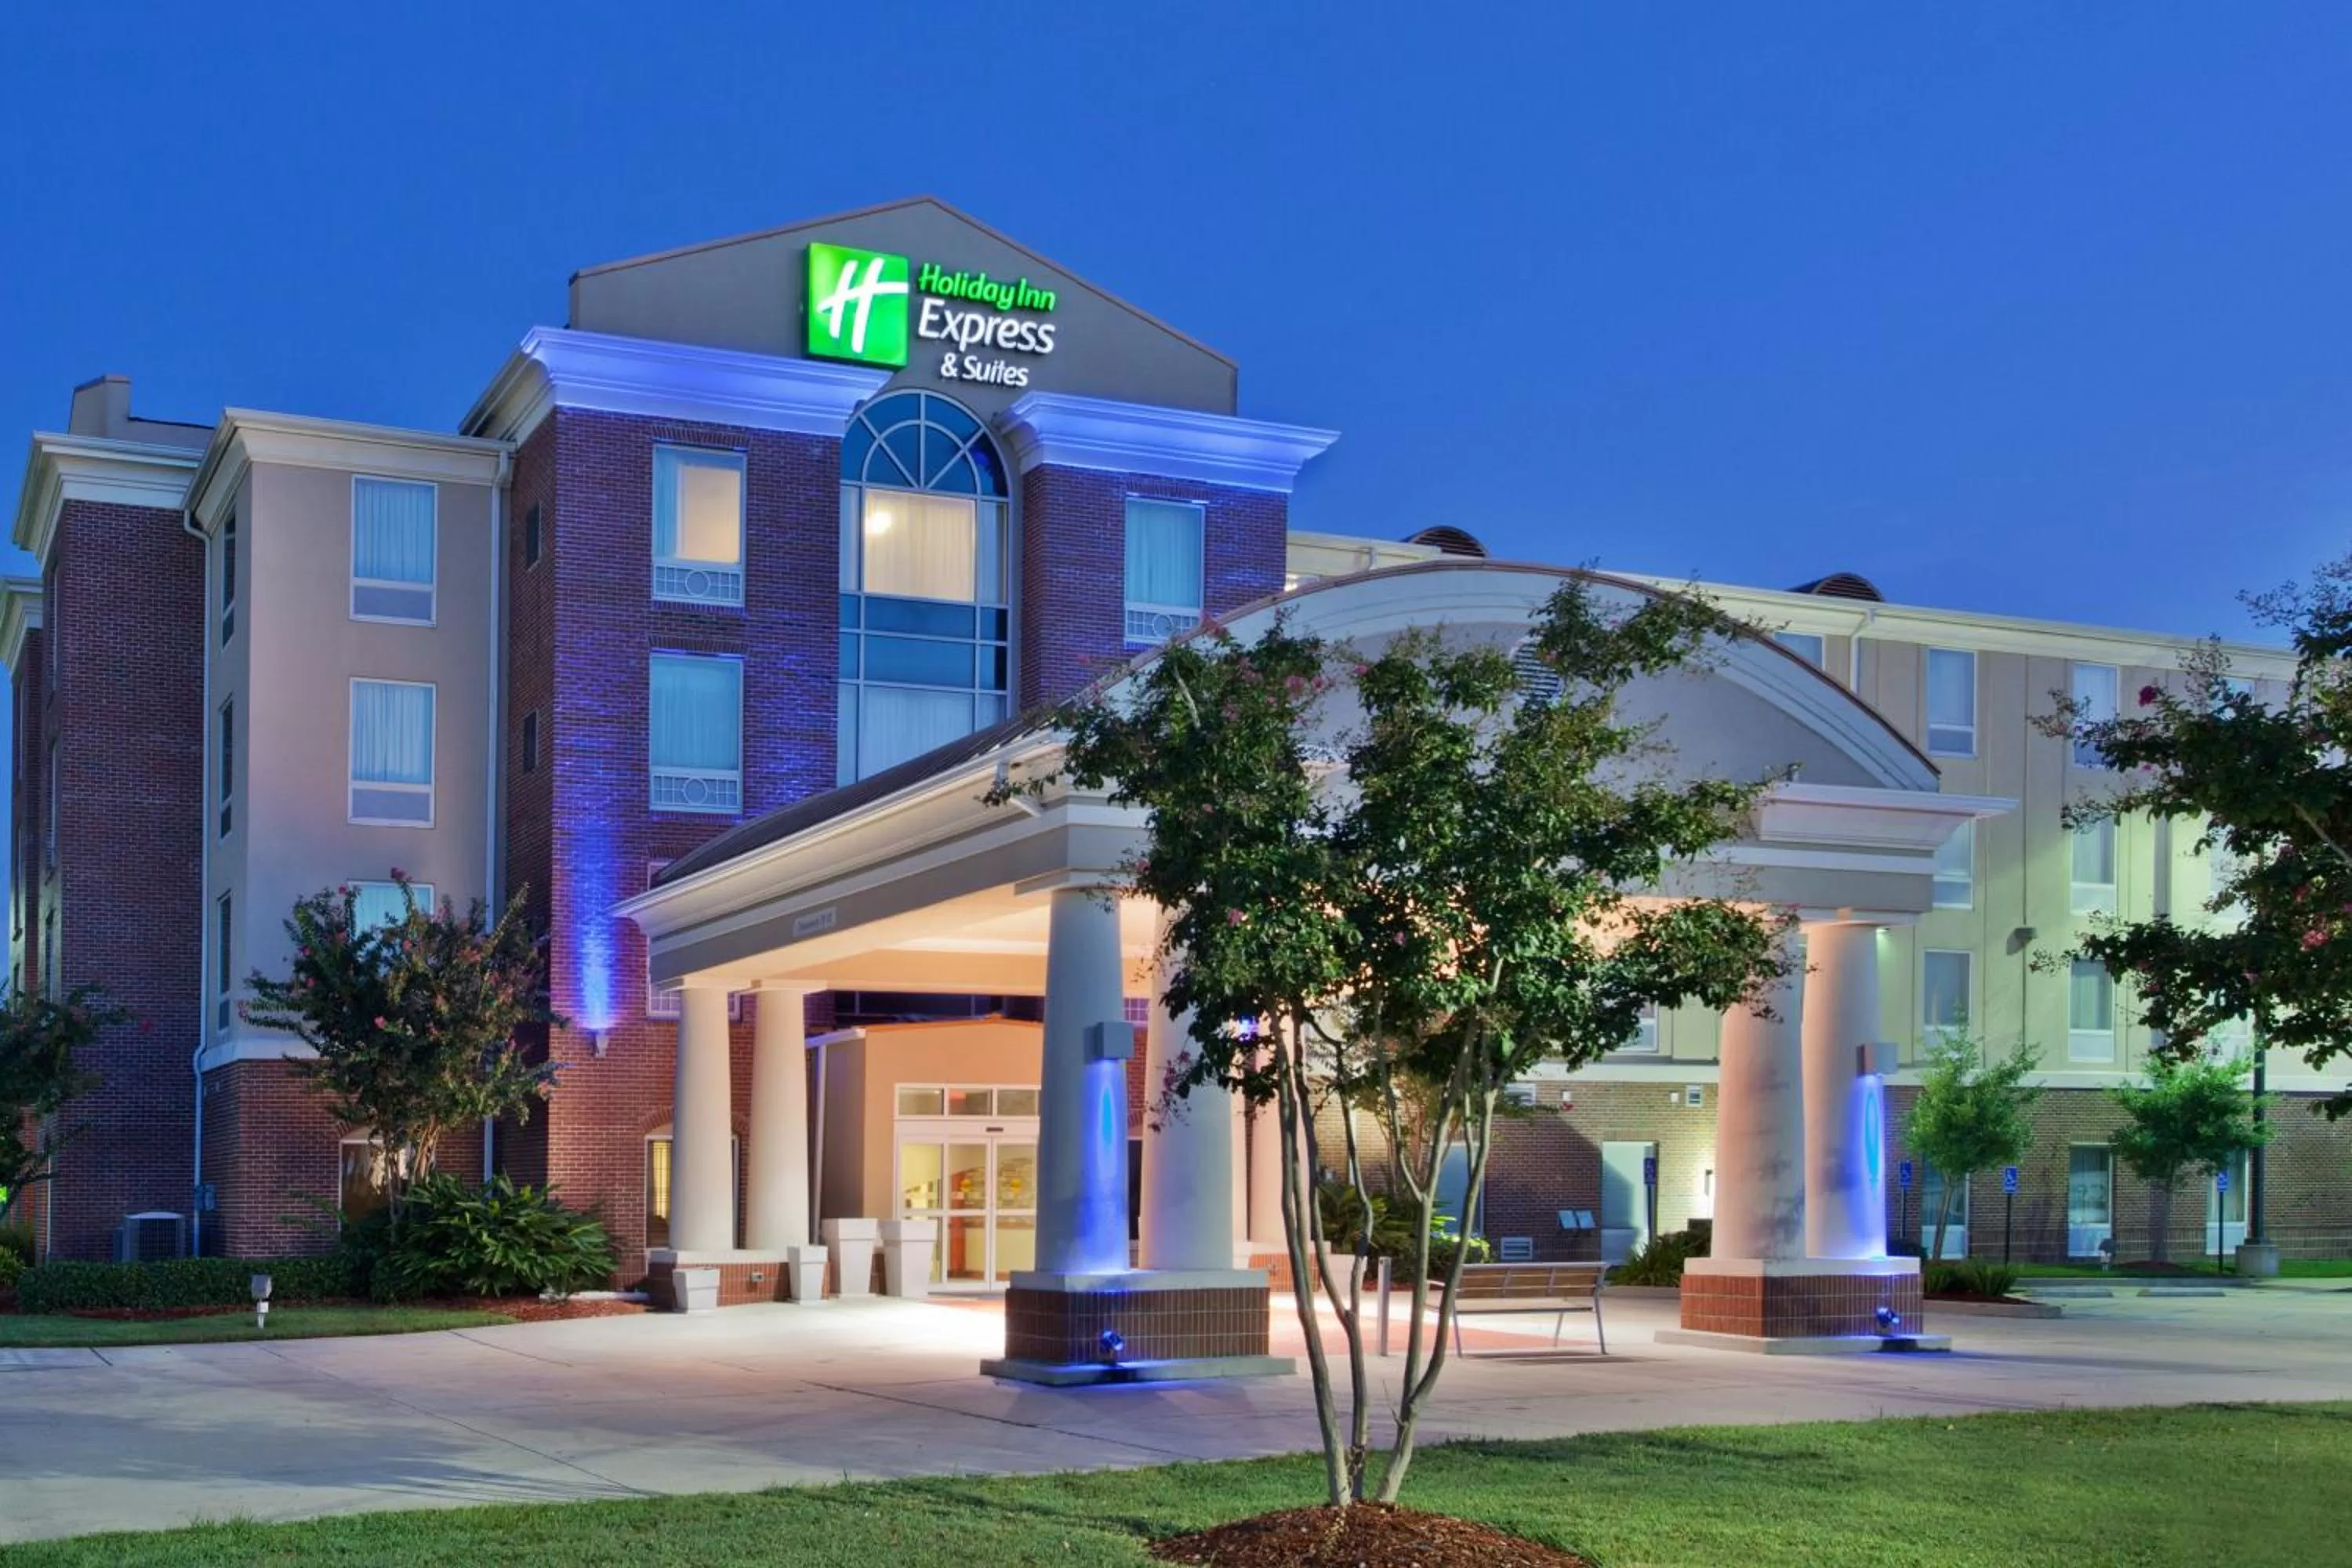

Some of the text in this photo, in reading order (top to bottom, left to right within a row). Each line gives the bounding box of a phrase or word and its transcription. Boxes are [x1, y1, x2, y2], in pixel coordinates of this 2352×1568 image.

[919, 263, 1056, 311] Holiday Inn
[918, 297, 1056, 353] Express
[941, 352, 1029, 387] & Suites
